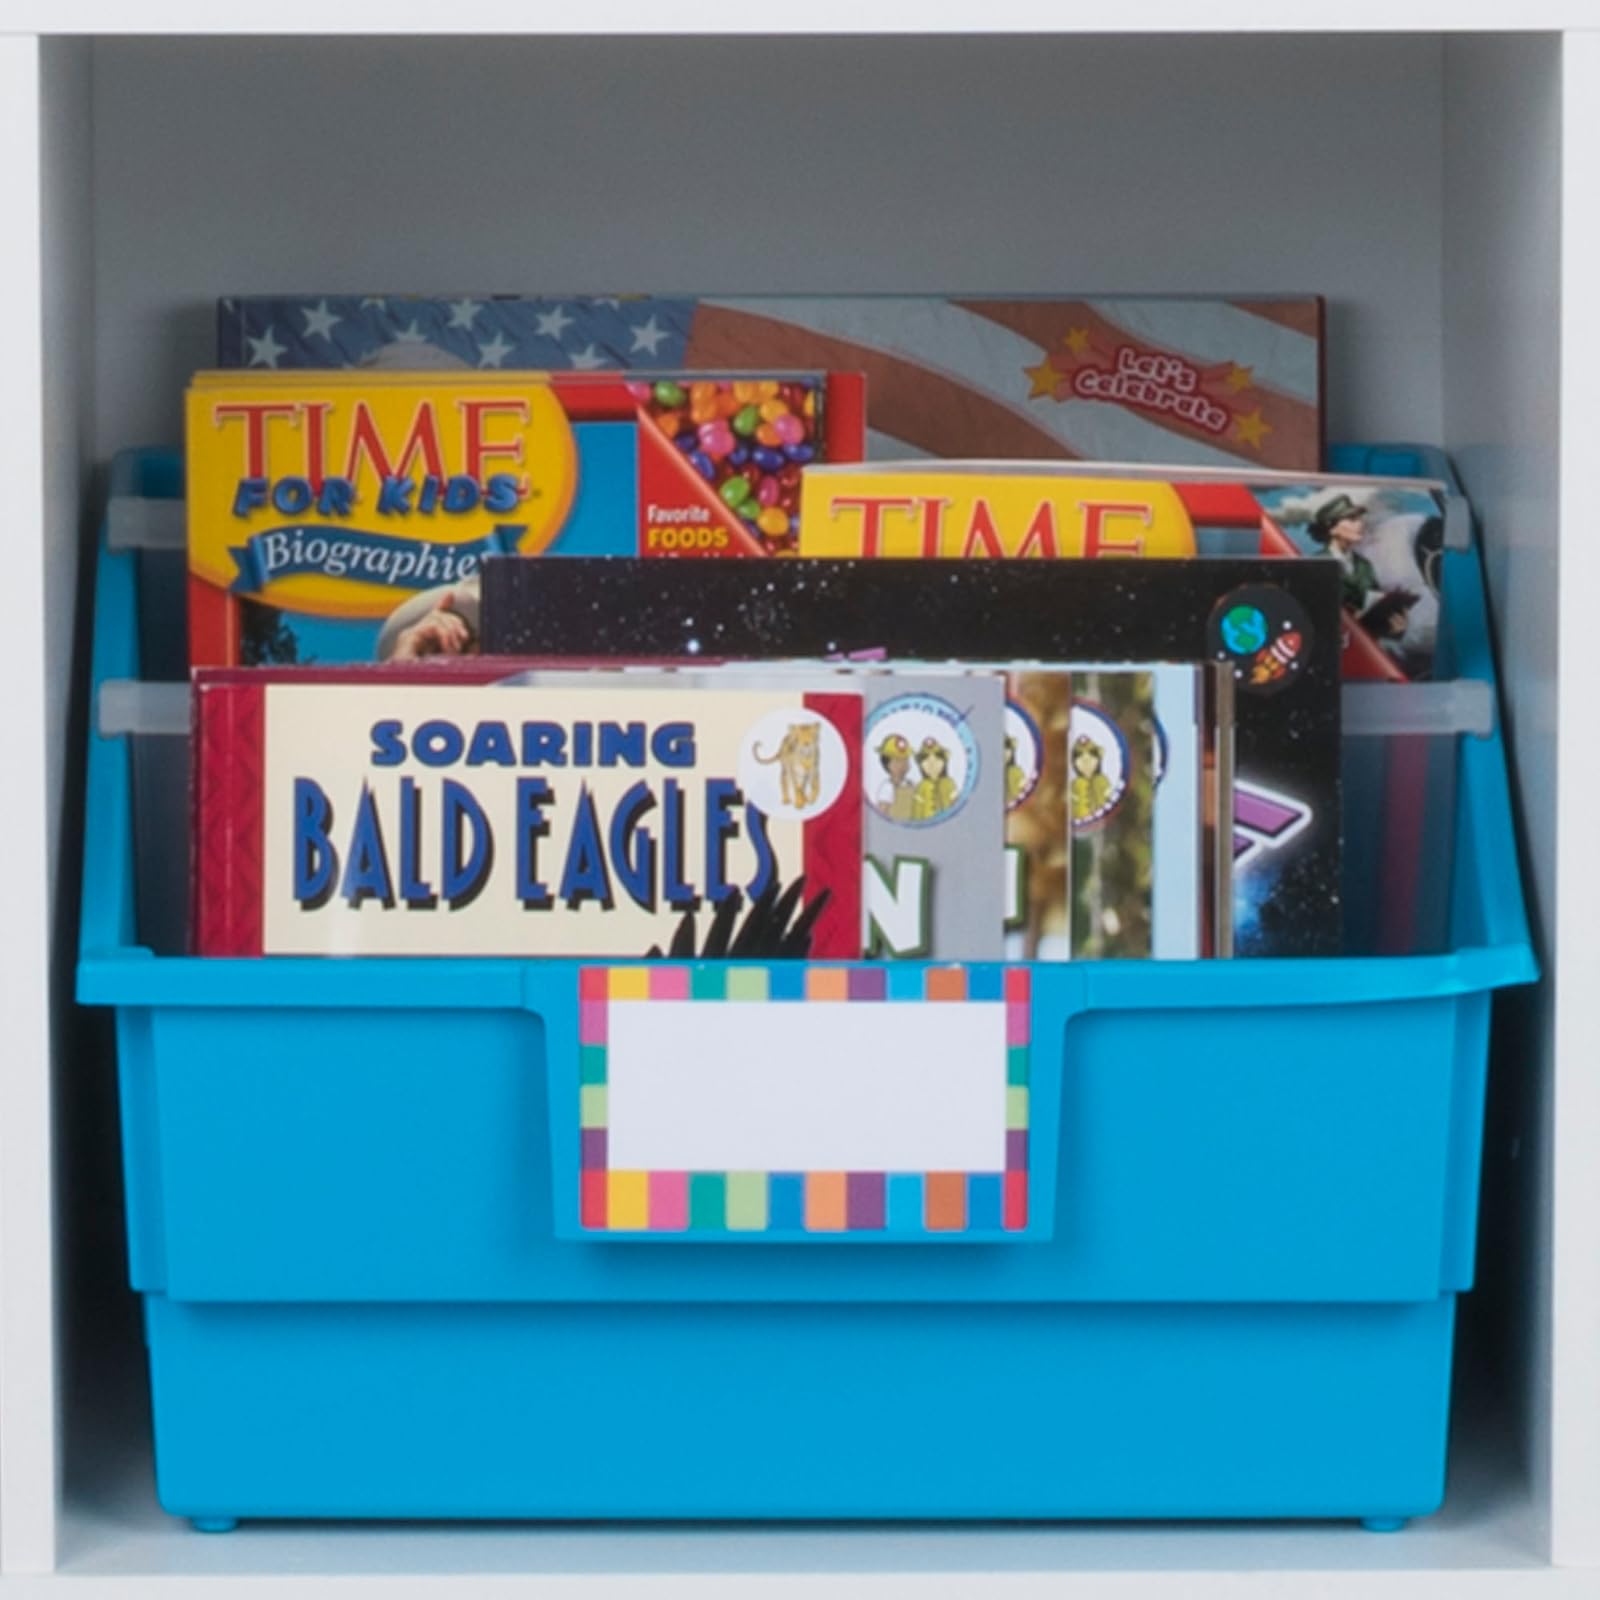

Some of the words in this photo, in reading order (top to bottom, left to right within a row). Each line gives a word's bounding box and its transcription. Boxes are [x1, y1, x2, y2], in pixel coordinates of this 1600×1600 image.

[1117, 347, 1196, 393] Let's
[1074, 368, 1228, 432] Celebrate
[213, 400, 530, 498] TIME
[232, 475, 355, 517] FOR
[376, 473, 519, 515] KIDS
[647, 504, 710, 524] Favorite
[648, 527, 729, 549] FOODS
[830, 495, 1152, 558] TIME
[264, 529, 488, 584] Biographie
[370, 720, 697, 767] SOARING
[293, 775, 495, 912] BALD
[515, 775, 781, 914] EAGLES
